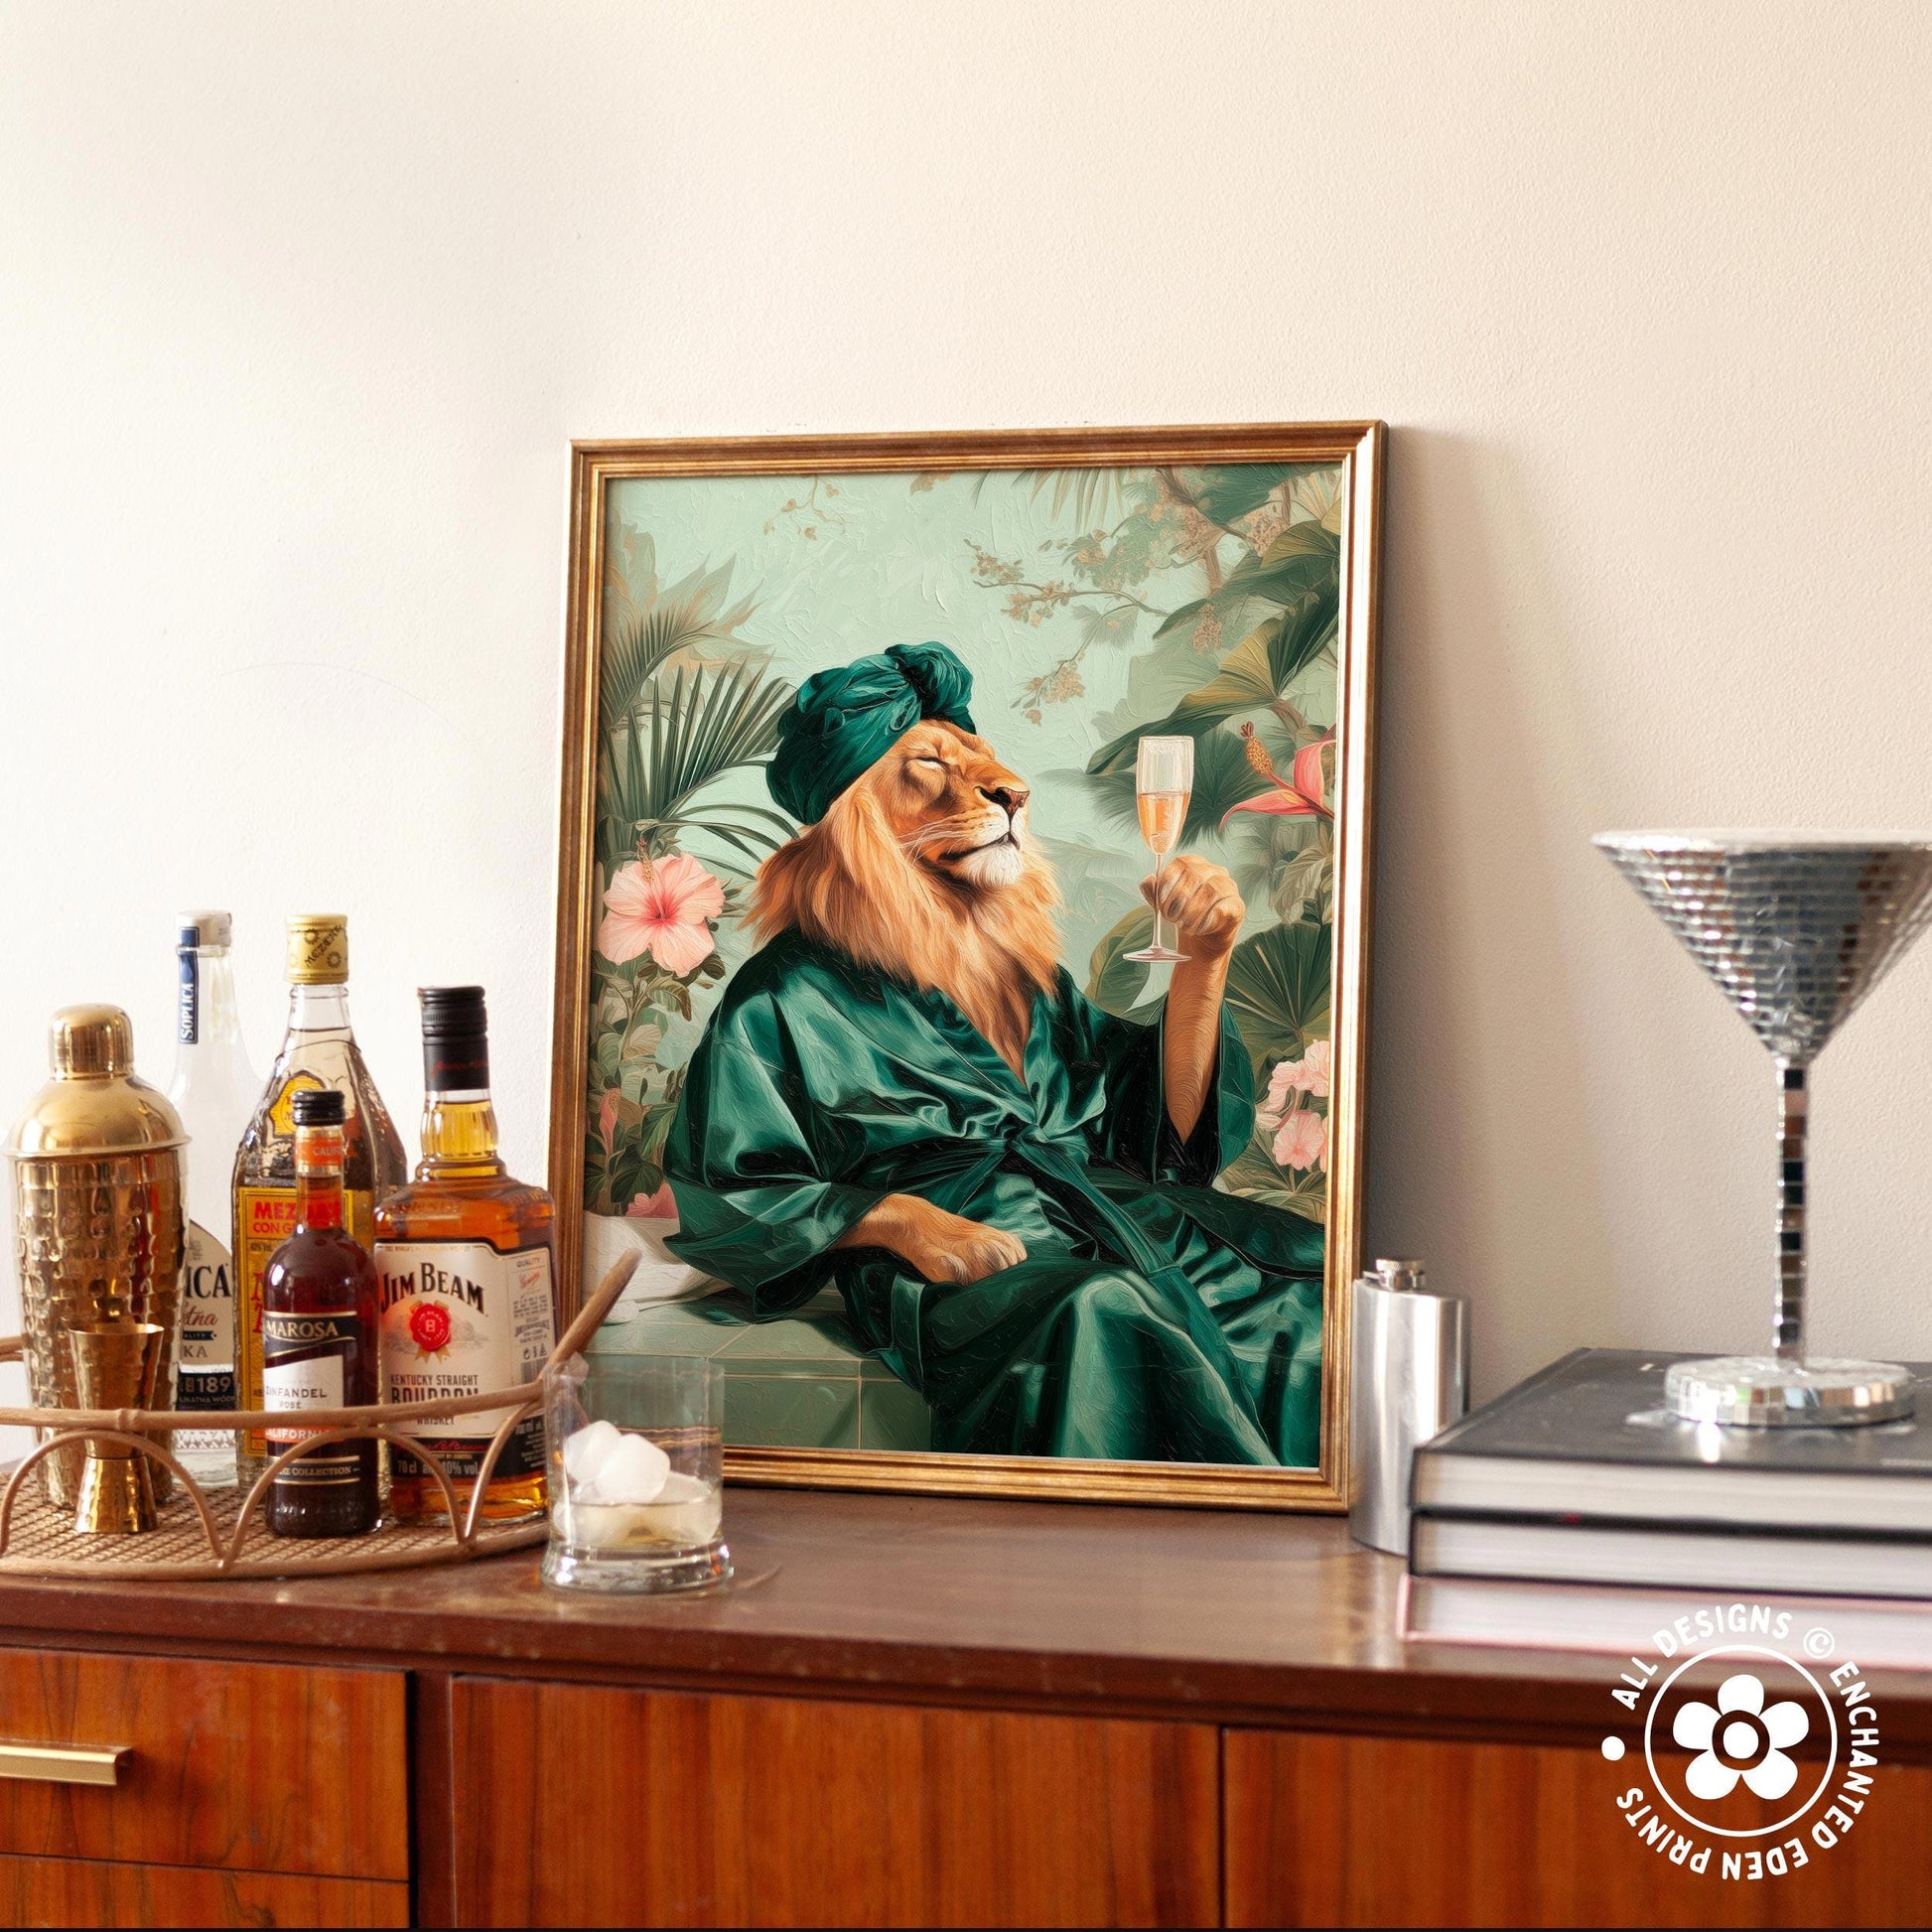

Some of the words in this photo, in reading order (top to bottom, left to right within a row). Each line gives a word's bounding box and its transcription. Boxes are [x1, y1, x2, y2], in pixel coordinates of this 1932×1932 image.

[182, 982, 195, 1040] SOPLICA
[253, 1222, 280, 1234] CON
[186, 1264, 230, 1299] ICA
[381, 1272, 417, 1315] JIM
[420, 1262, 485, 1315] BEAM
[197, 1376, 232, 1393] 189
[390, 1374, 434, 1386] KENTUCKY
[436, 1374, 479, 1386] STRAIGHT
[265, 1386, 328, 1399] ZINFANDEL
[292, 1466, 351, 1476] COLLECTION
